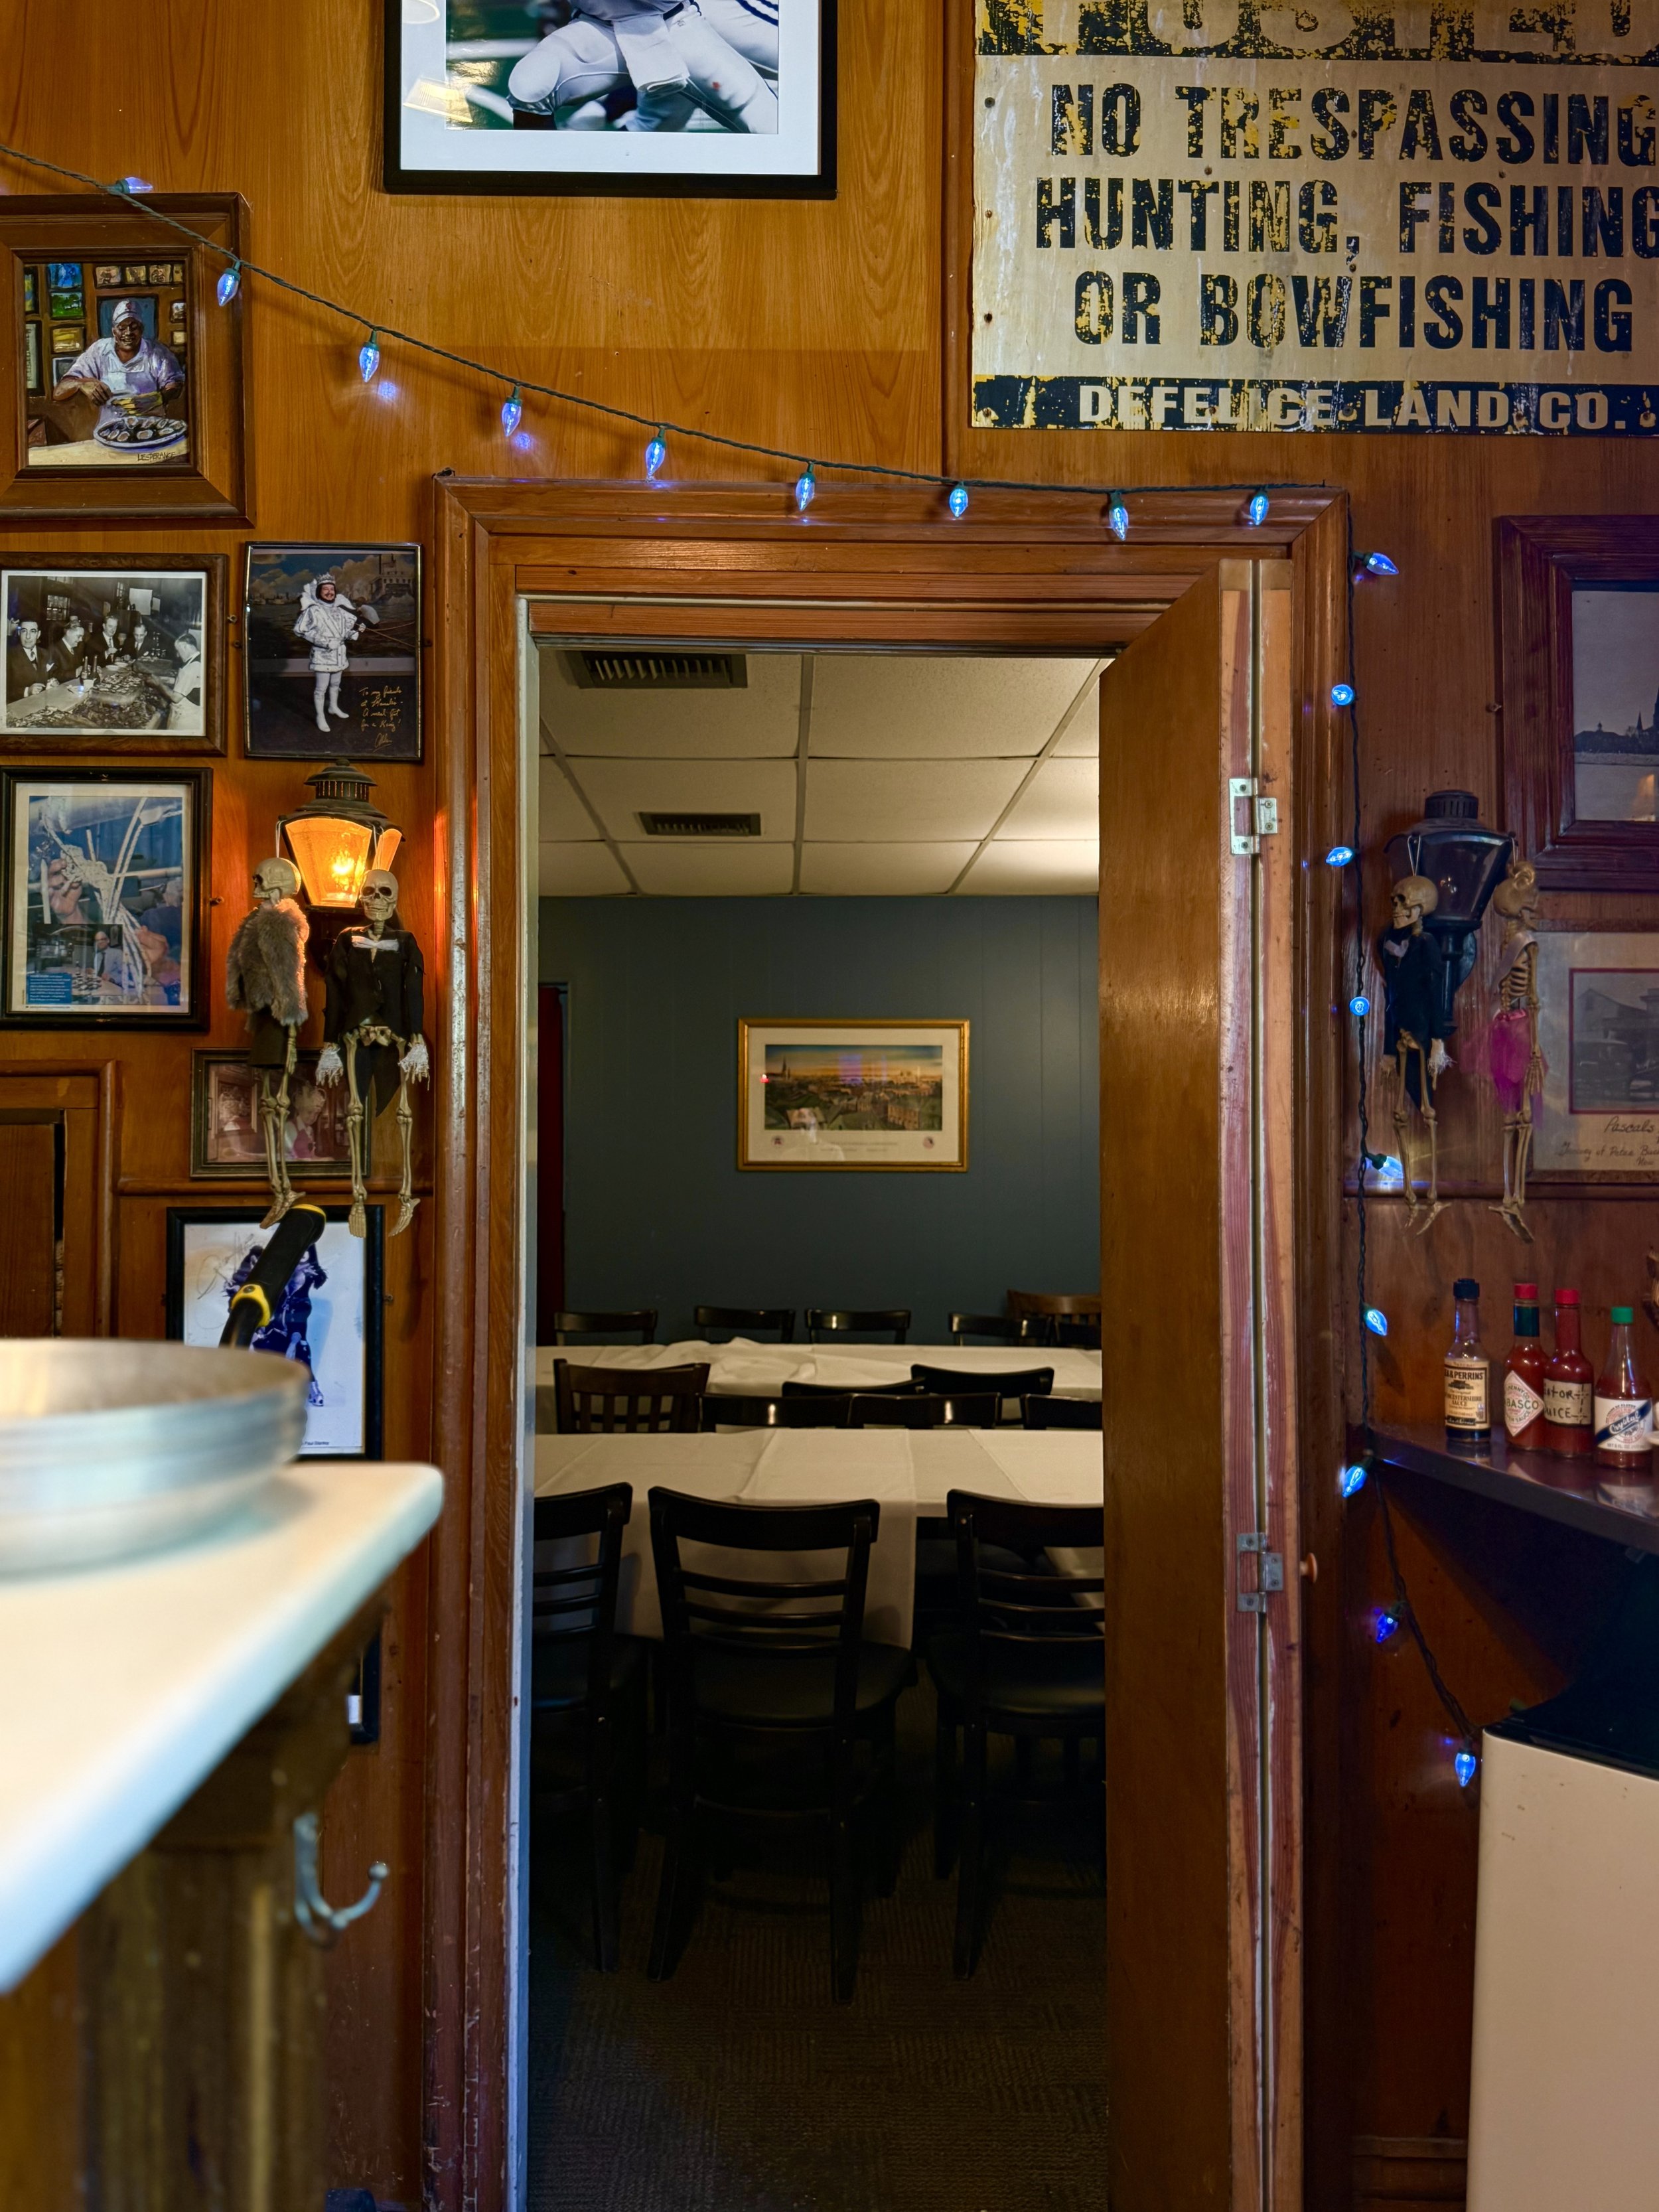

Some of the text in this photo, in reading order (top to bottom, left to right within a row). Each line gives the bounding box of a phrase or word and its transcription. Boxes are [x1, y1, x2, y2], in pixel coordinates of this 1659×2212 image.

[1051, 84, 1656, 167] NO TRESPASSING
[1036, 177, 1659, 265] HUNTING, FISHING
[1074, 270, 1632, 352] OR BOWFISHING
[1364, 390, 1510, 428] LAND
[1539, 391, 1626, 430] CO.
